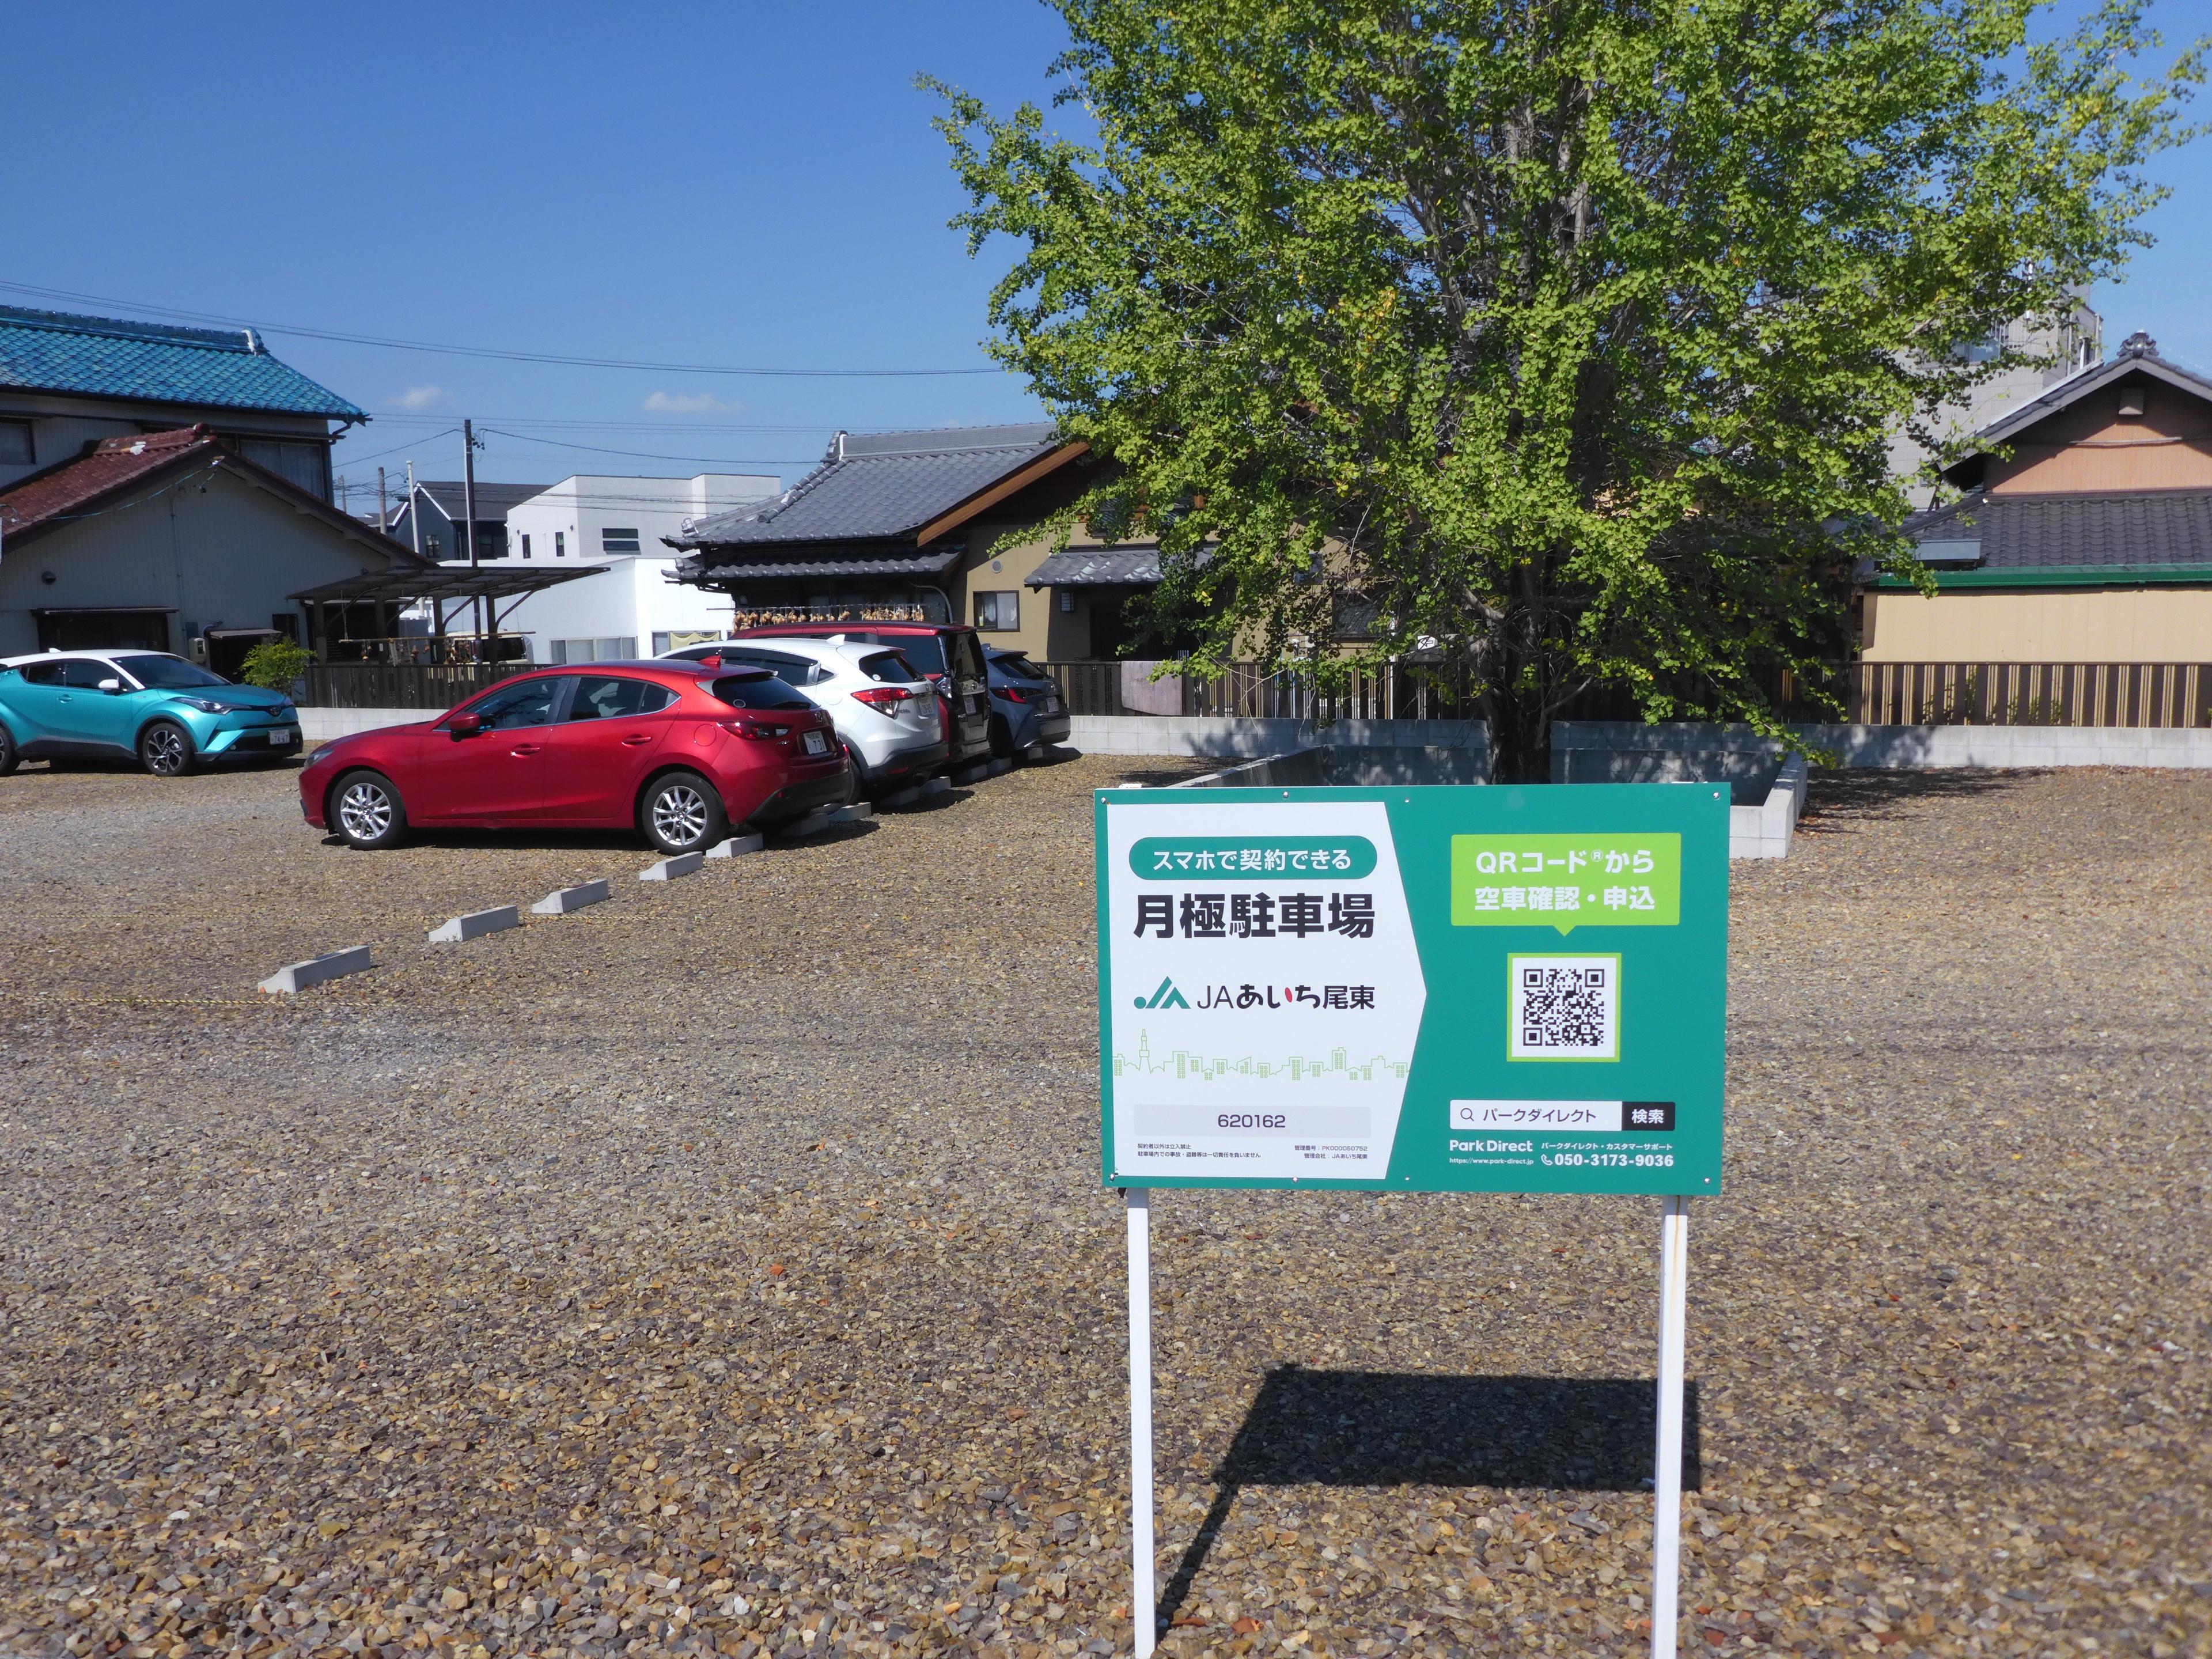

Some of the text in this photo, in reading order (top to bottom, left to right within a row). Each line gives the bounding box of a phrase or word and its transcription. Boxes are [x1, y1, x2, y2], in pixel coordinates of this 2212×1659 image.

[1153, 849, 1351, 871] スマホで契約できる
[1475, 885, 1656, 911] 空車確認・申込
[1133, 892, 1375, 939] 月極駐車場
[1197, 984, 1375, 1010] JAあいち尾東
[1218, 1114, 1286, 1128] 620162
[1483, 1108, 1596, 1123] パークダイレクト
[1631, 1108, 1664, 1124] 検索
[1449, 1139, 1533, 1152] Park Direct
[1541, 1142, 1673, 1151] パークダイレクト・カスタマーサポート
[1449, 1157, 1534, 1165] https://www.park-direct.jp
[1554, 1153, 1675, 1167] 050-3173-9036
